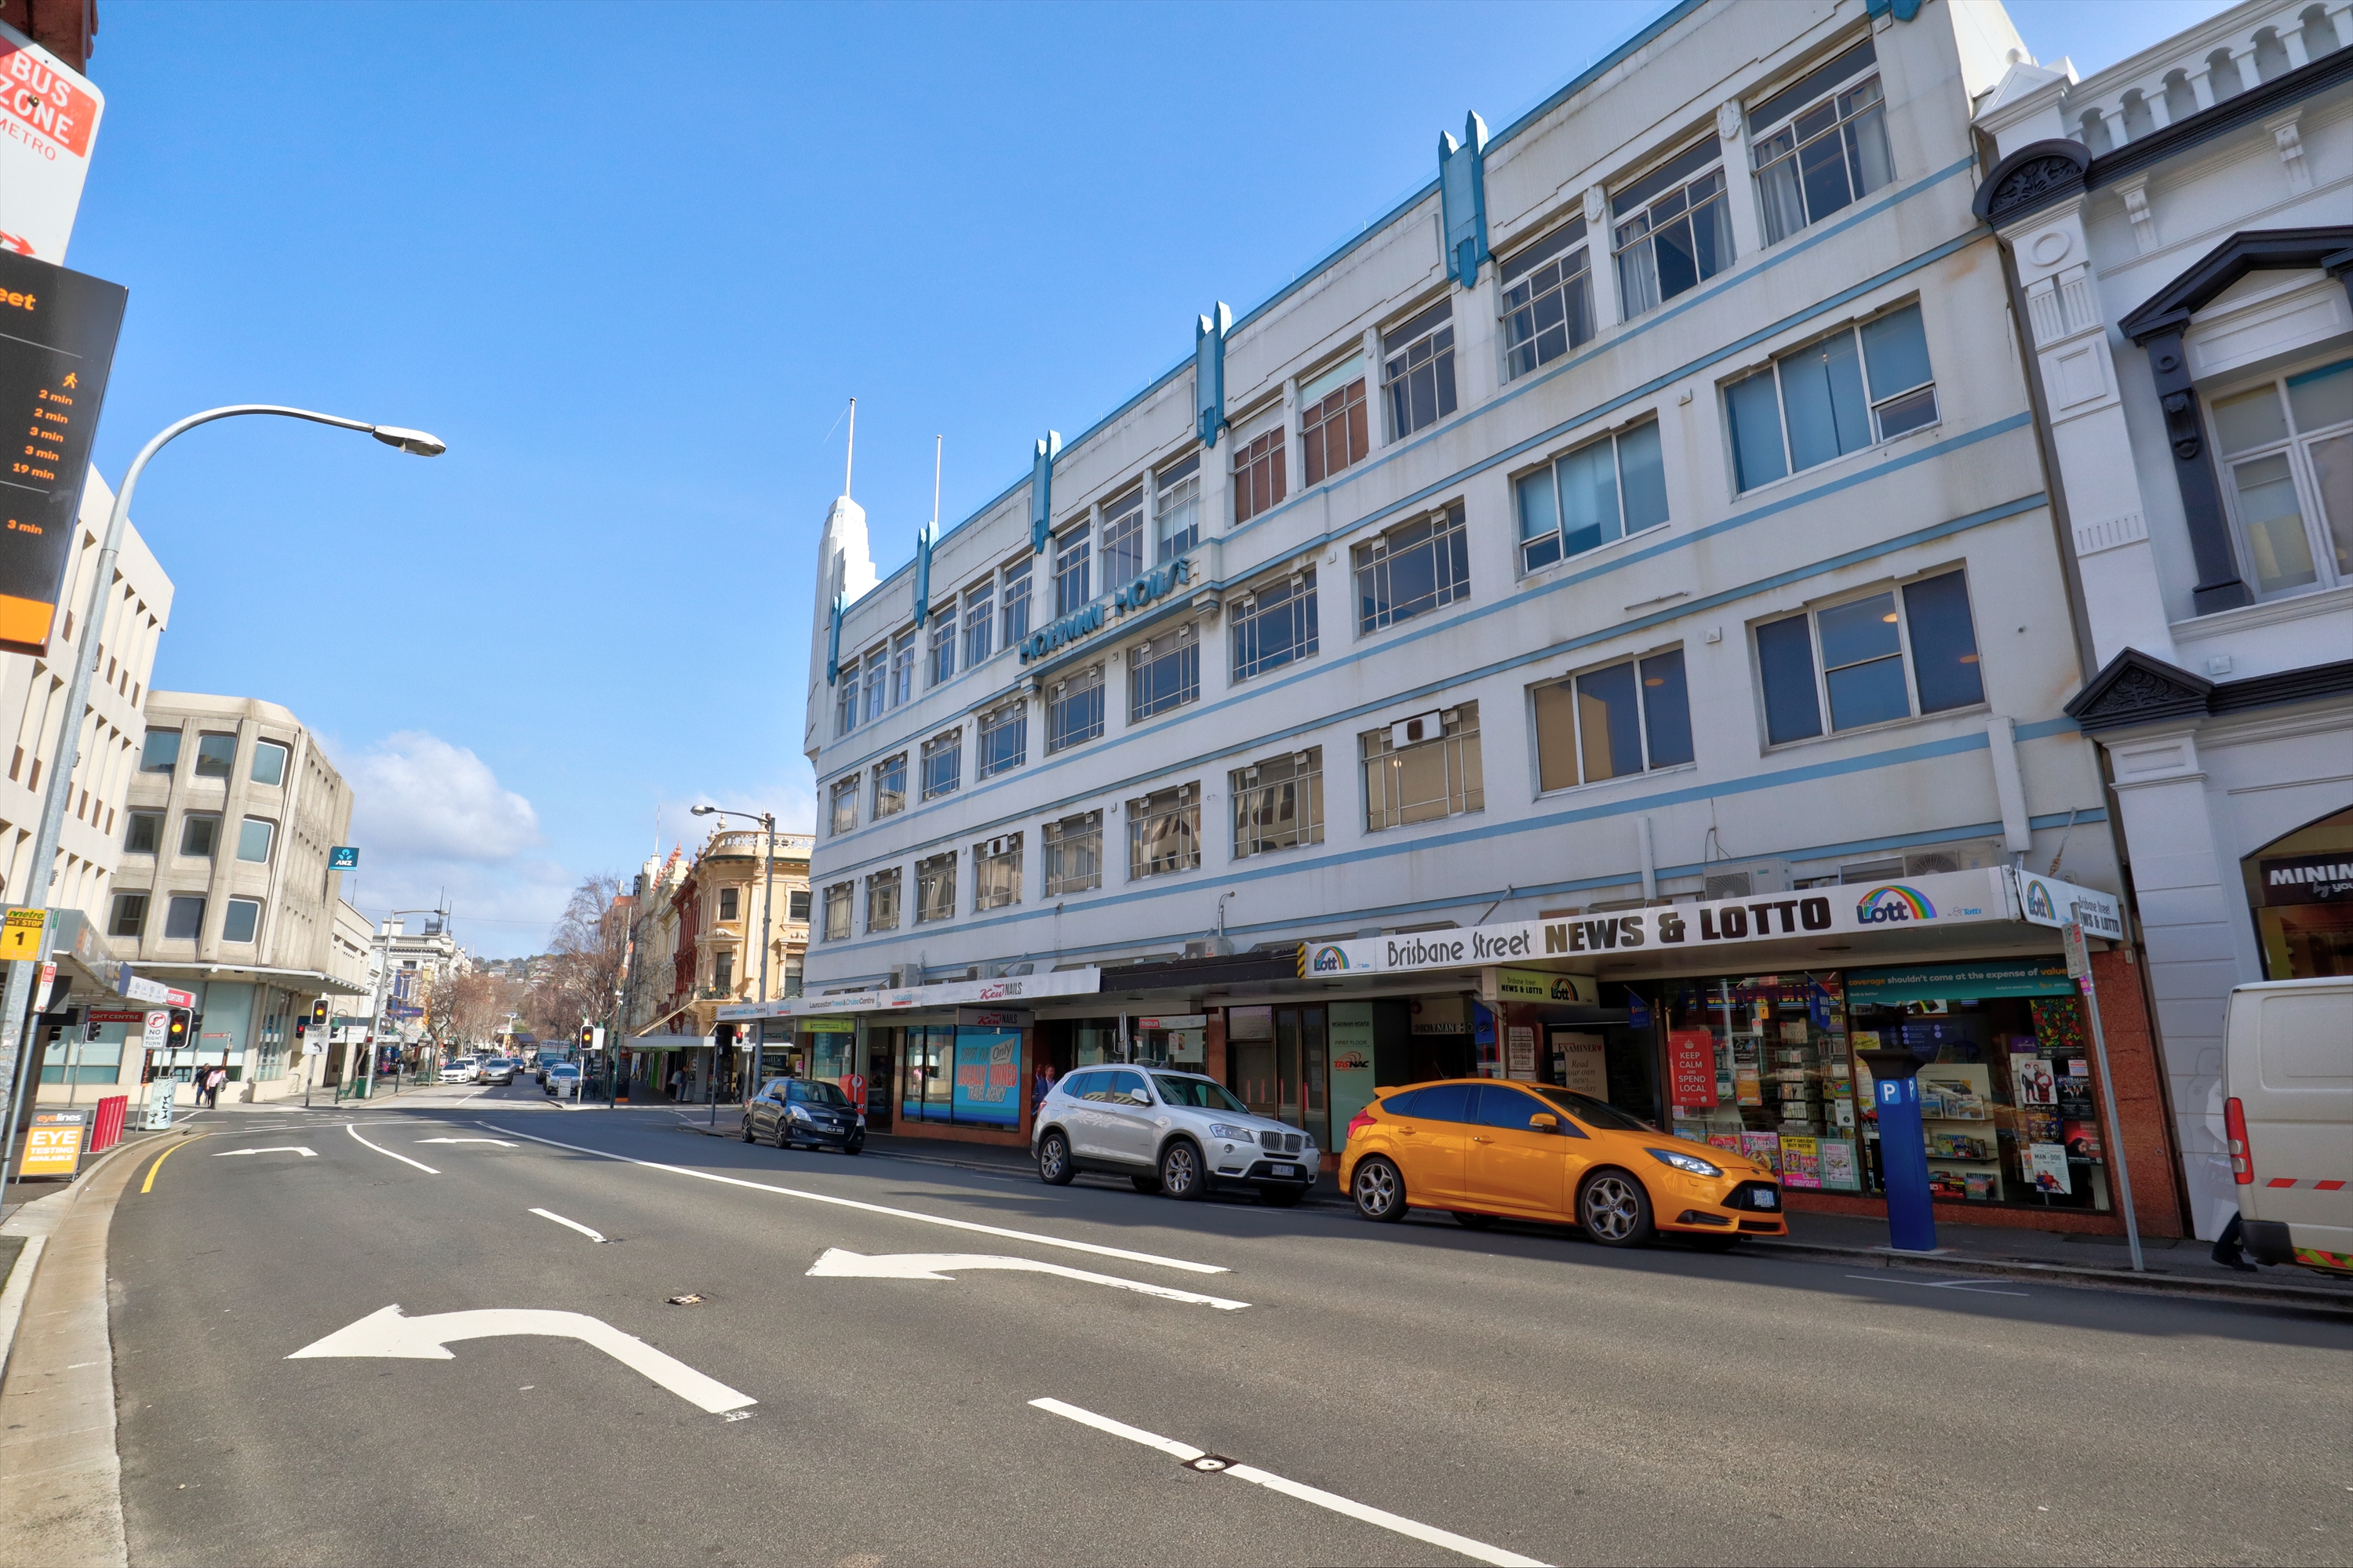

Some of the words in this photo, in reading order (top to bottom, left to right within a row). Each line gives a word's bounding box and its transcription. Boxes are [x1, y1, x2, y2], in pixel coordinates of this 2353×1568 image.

[11, 52, 71, 107] BUS
[0, 77, 74, 144] ZONE
[38, 389, 48, 399] 2
[49, 391, 73, 406] min
[35, 408, 43, 418] 2
[45, 410, 68, 424] min
[30, 427, 38, 437] 3
[41, 429, 64, 443] min
[25, 446, 34, 456] 3
[36, 448, 60, 462] min
[13, 462, 30, 474] 19
[31, 467, 55, 481] min
[7, 519, 16, 530] 3
[20, 522, 42, 535] min
[1019, 602, 1105, 665] HOLYMAN
[1115, 557, 1190, 617] HOUSE
[1856, 901, 1908, 924] Lott
[1963, 908, 1982, 916] Tatts
[2027, 894, 2047, 919] Lott
[1544, 915, 1645, 955] NEWS
[1657, 911, 1685, 944] &
[1699, 897, 1832, 940] LOTTO
[2094, 916, 2100, 929] &
[2100, 917, 2120, 933] LOTTO
[15, 931, 25, 946] 1
[1387, 937, 1465, 967] Brisbane
[1473, 930, 1531, 959] Street
[1314, 957, 1337, 971] Lott
[42, 973, 53, 982] ZONE
[1887, 974, 1928, 984] shouldn't
[1986, 970, 2025, 980] expense
[2027, 968, 2038, 977] of
[2040, 967, 2067, 976] value
[1005, 982, 1022, 996] NAILS
[1501, 984, 1519, 993] NEWS
[1551, 987, 1569, 1000] Lott
[1819, 995, 1830, 1006] NOW
[1001, 1013, 1018, 1024] NAILS
[1820, 1006, 1831, 1017] OPEN
[993, 1043, 1012, 1060] Only
[1558, 1042, 1597, 1053] EXAMINER
[1679, 1051, 1700, 1060] KEEP
[1679, 1060, 1703, 1069] CALM
[957, 1063, 987, 1086] LOCALLY
[989, 1063, 1018, 1088] OWNED
[1678, 1075, 1706, 1083] SPEND
[967, 1086, 985, 1102] TRAVEL
[985, 1086, 1007, 1104] AGENCY
[1679, 1084, 1706, 1093] LOCAL
[1883, 1083, 1896, 1101] P
[1908, 1080, 1914, 1097] P
[36, 1113, 82, 1123] eyelines
[31, 1130, 78, 1145] EYE
